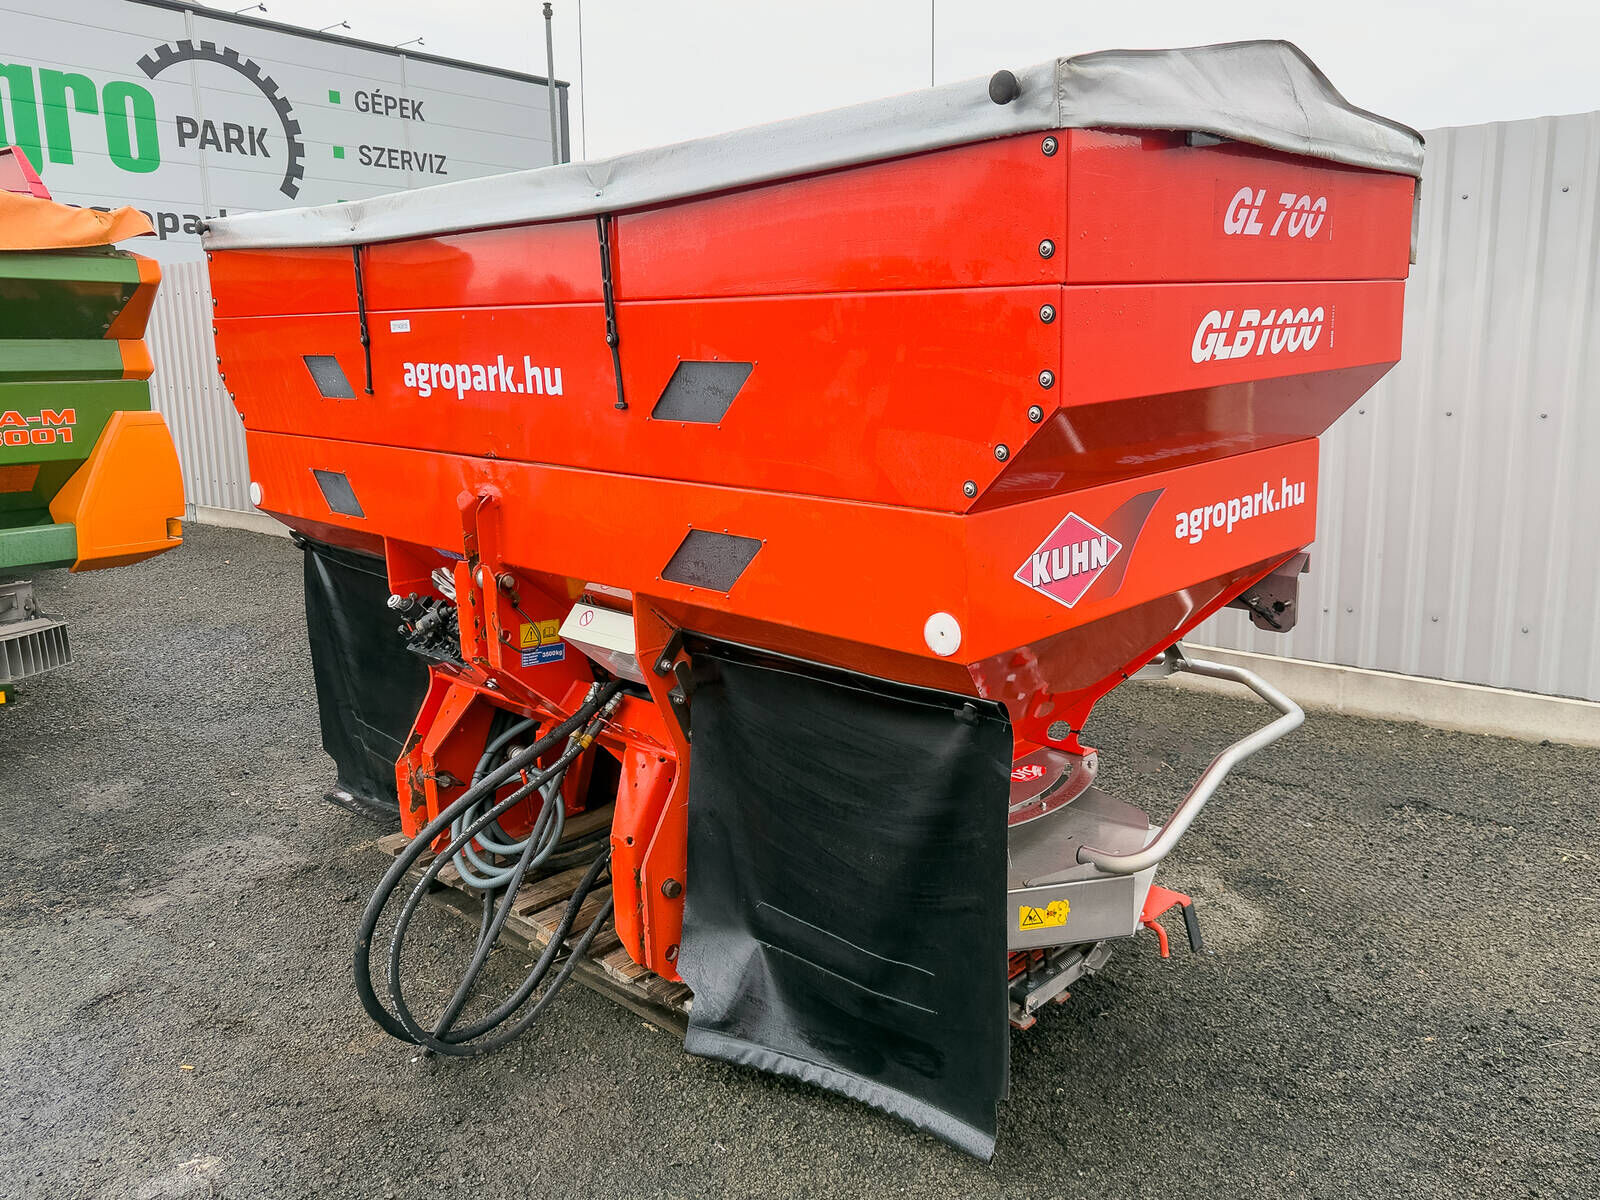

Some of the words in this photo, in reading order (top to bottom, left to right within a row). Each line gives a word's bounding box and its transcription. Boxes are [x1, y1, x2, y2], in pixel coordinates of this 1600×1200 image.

[354, 89, 425, 122] GÉPEK
[176, 115, 271, 158] PARK
[358, 145, 448, 175] SZERVIZ
[1224, 186, 1266, 235] GL
[1270, 193, 1327, 238] 700
[403, 355, 563, 400] agropark.hu
[1175, 477, 1305, 544] agropark.hu
[1031, 535, 1108, 587] KUHN
